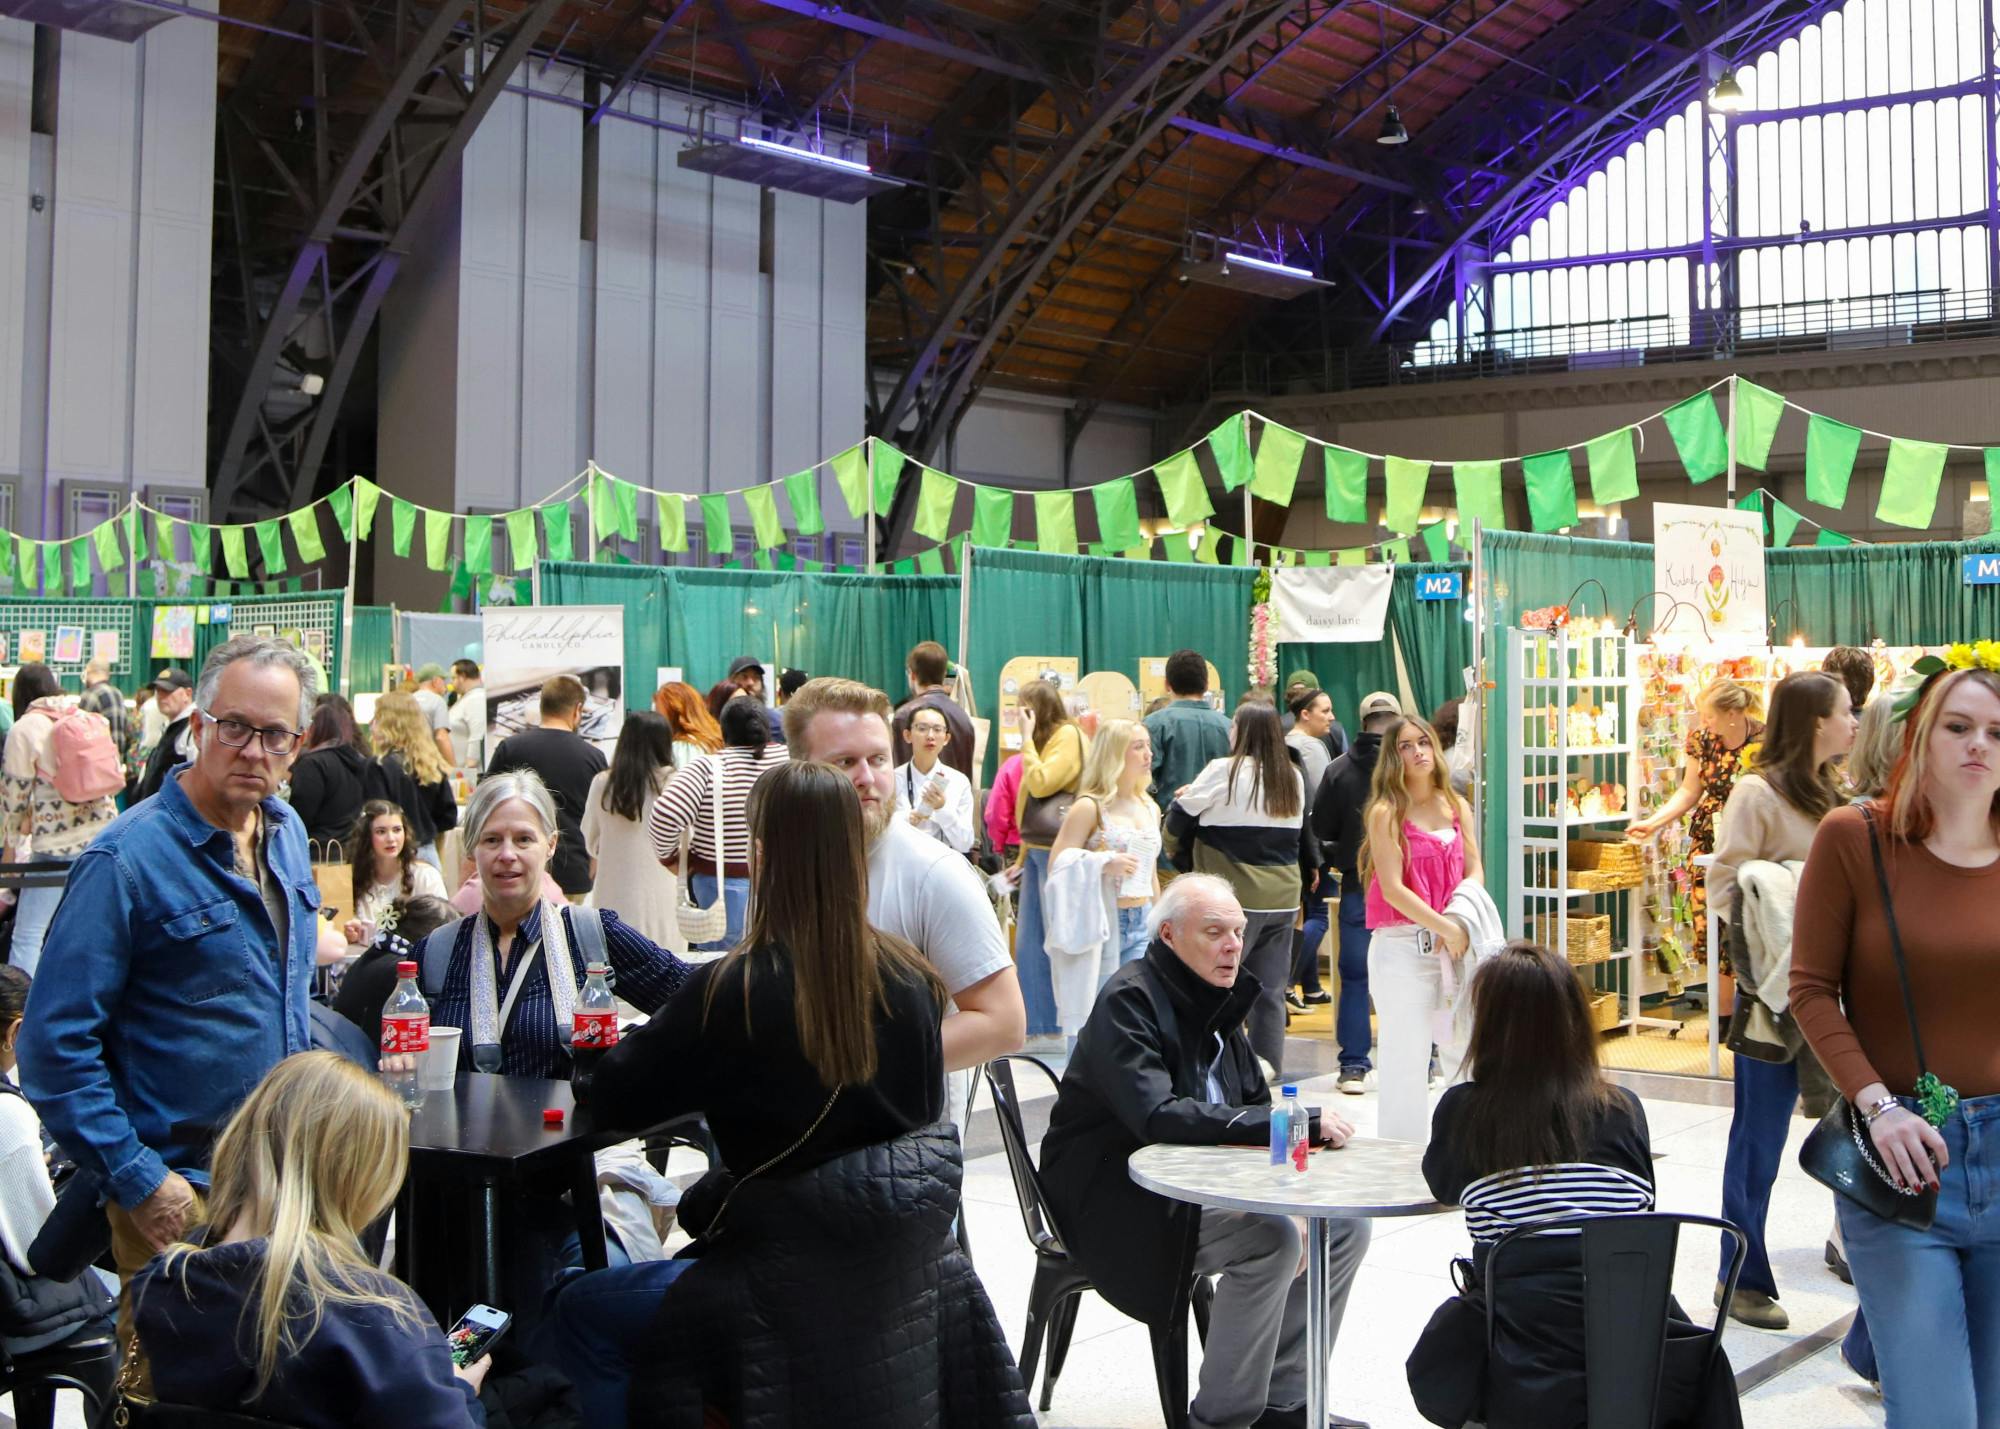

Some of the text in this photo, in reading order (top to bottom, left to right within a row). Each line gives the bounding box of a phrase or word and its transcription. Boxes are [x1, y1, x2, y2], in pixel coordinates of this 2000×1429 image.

[1978, 559, 2000, 577] M
[1425, 577, 1452, 594] M2
[1306, 614, 1361, 628] daisy lane
[485, 615, 618, 656] Philadelphia
[521, 641, 562, 649] CANDLE
